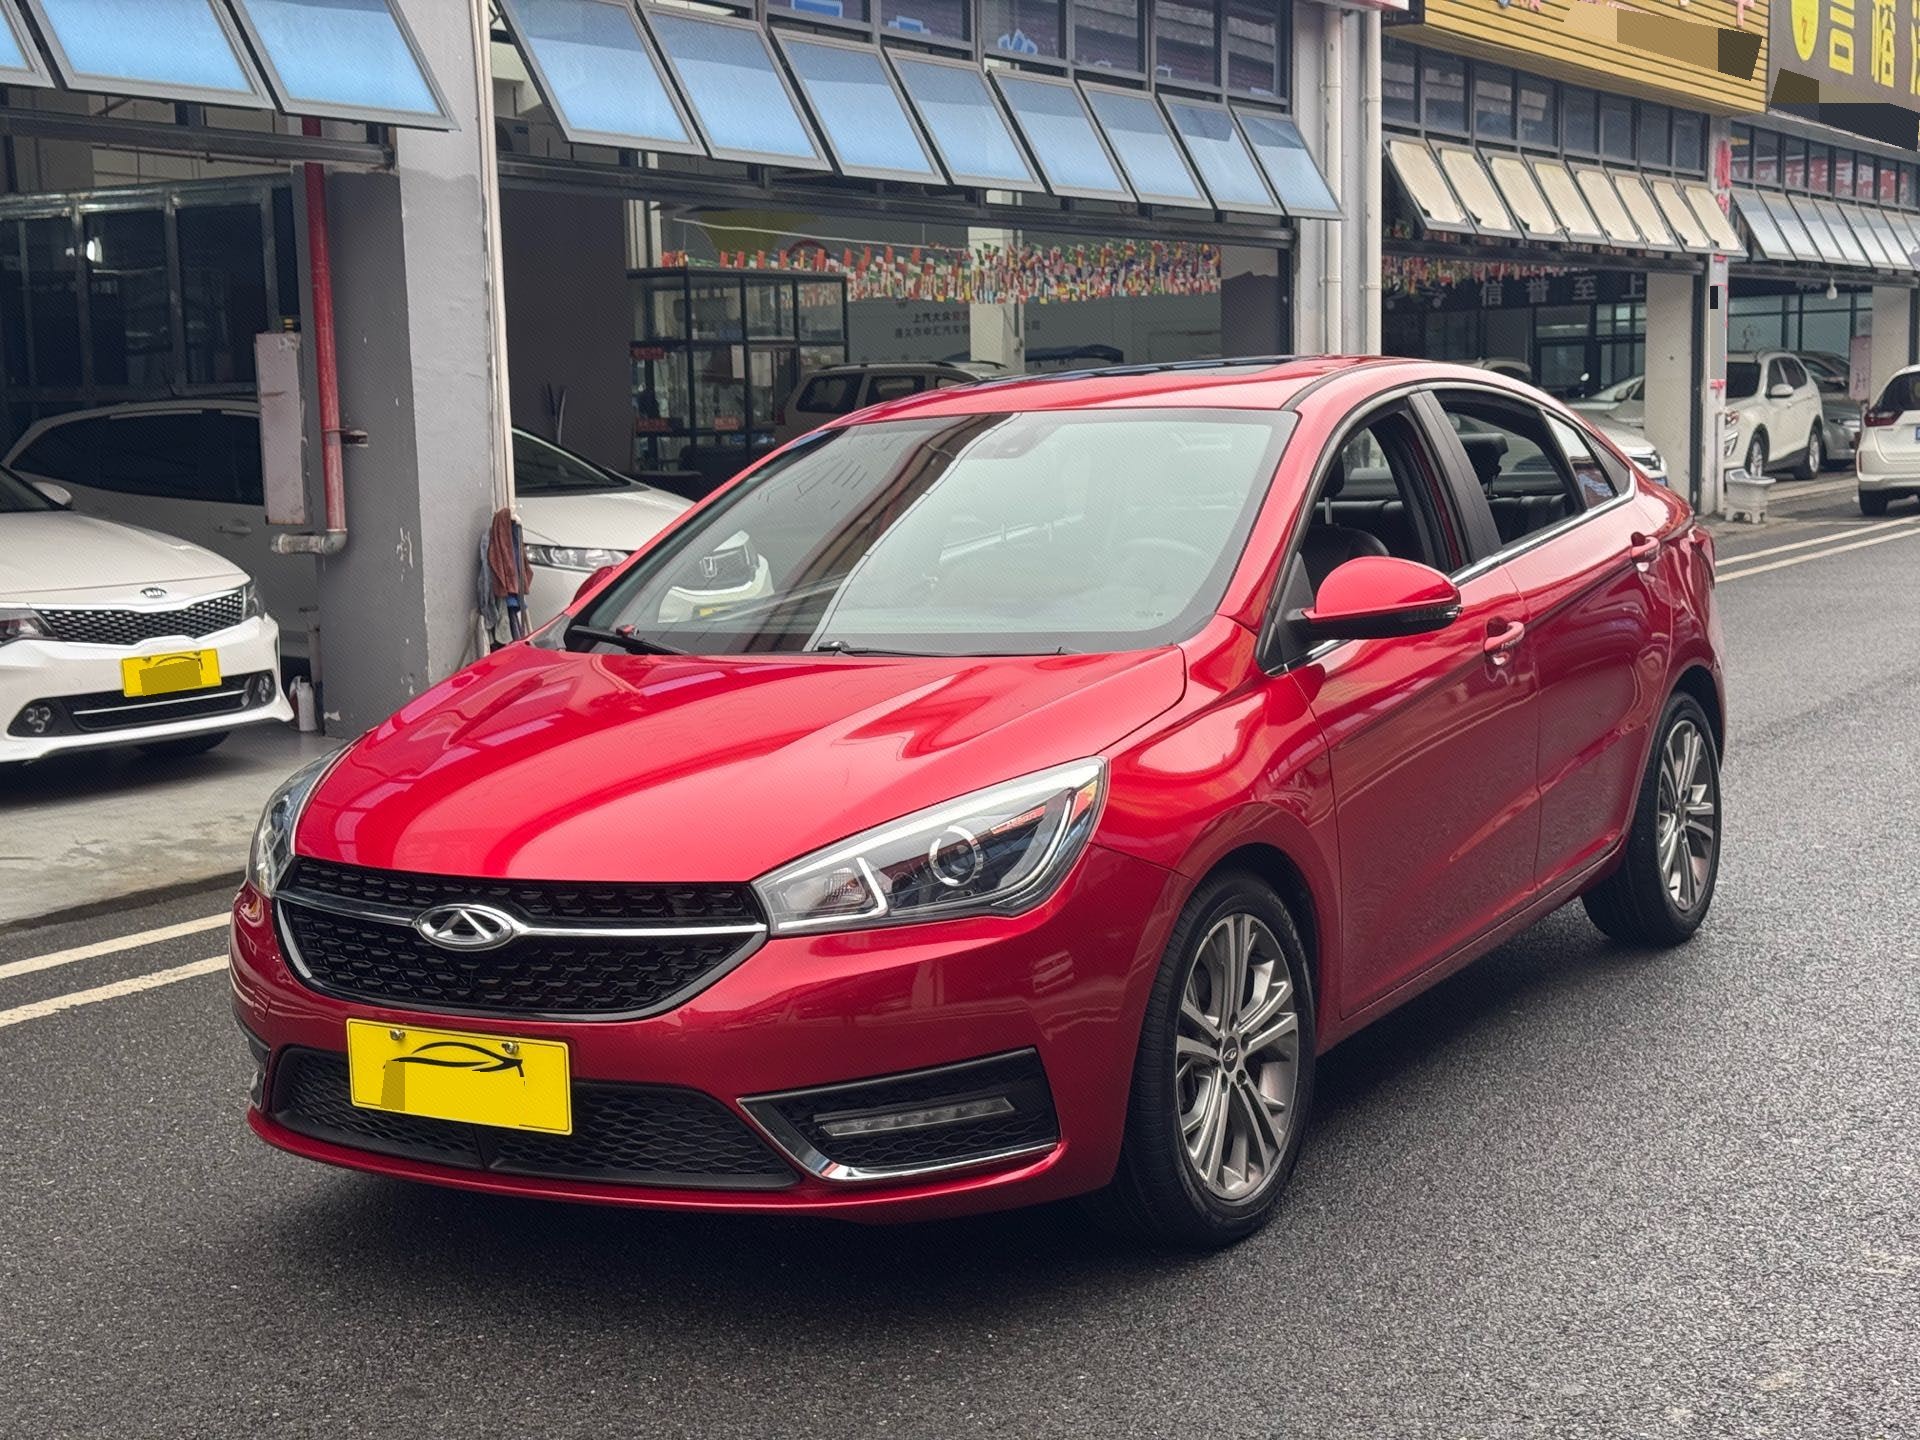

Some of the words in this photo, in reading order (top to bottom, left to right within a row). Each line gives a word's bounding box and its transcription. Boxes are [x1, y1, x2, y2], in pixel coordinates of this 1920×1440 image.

[1480, 274, 1645, 306] 信誉至上
[913, 310, 970, 324] 上汽大众
